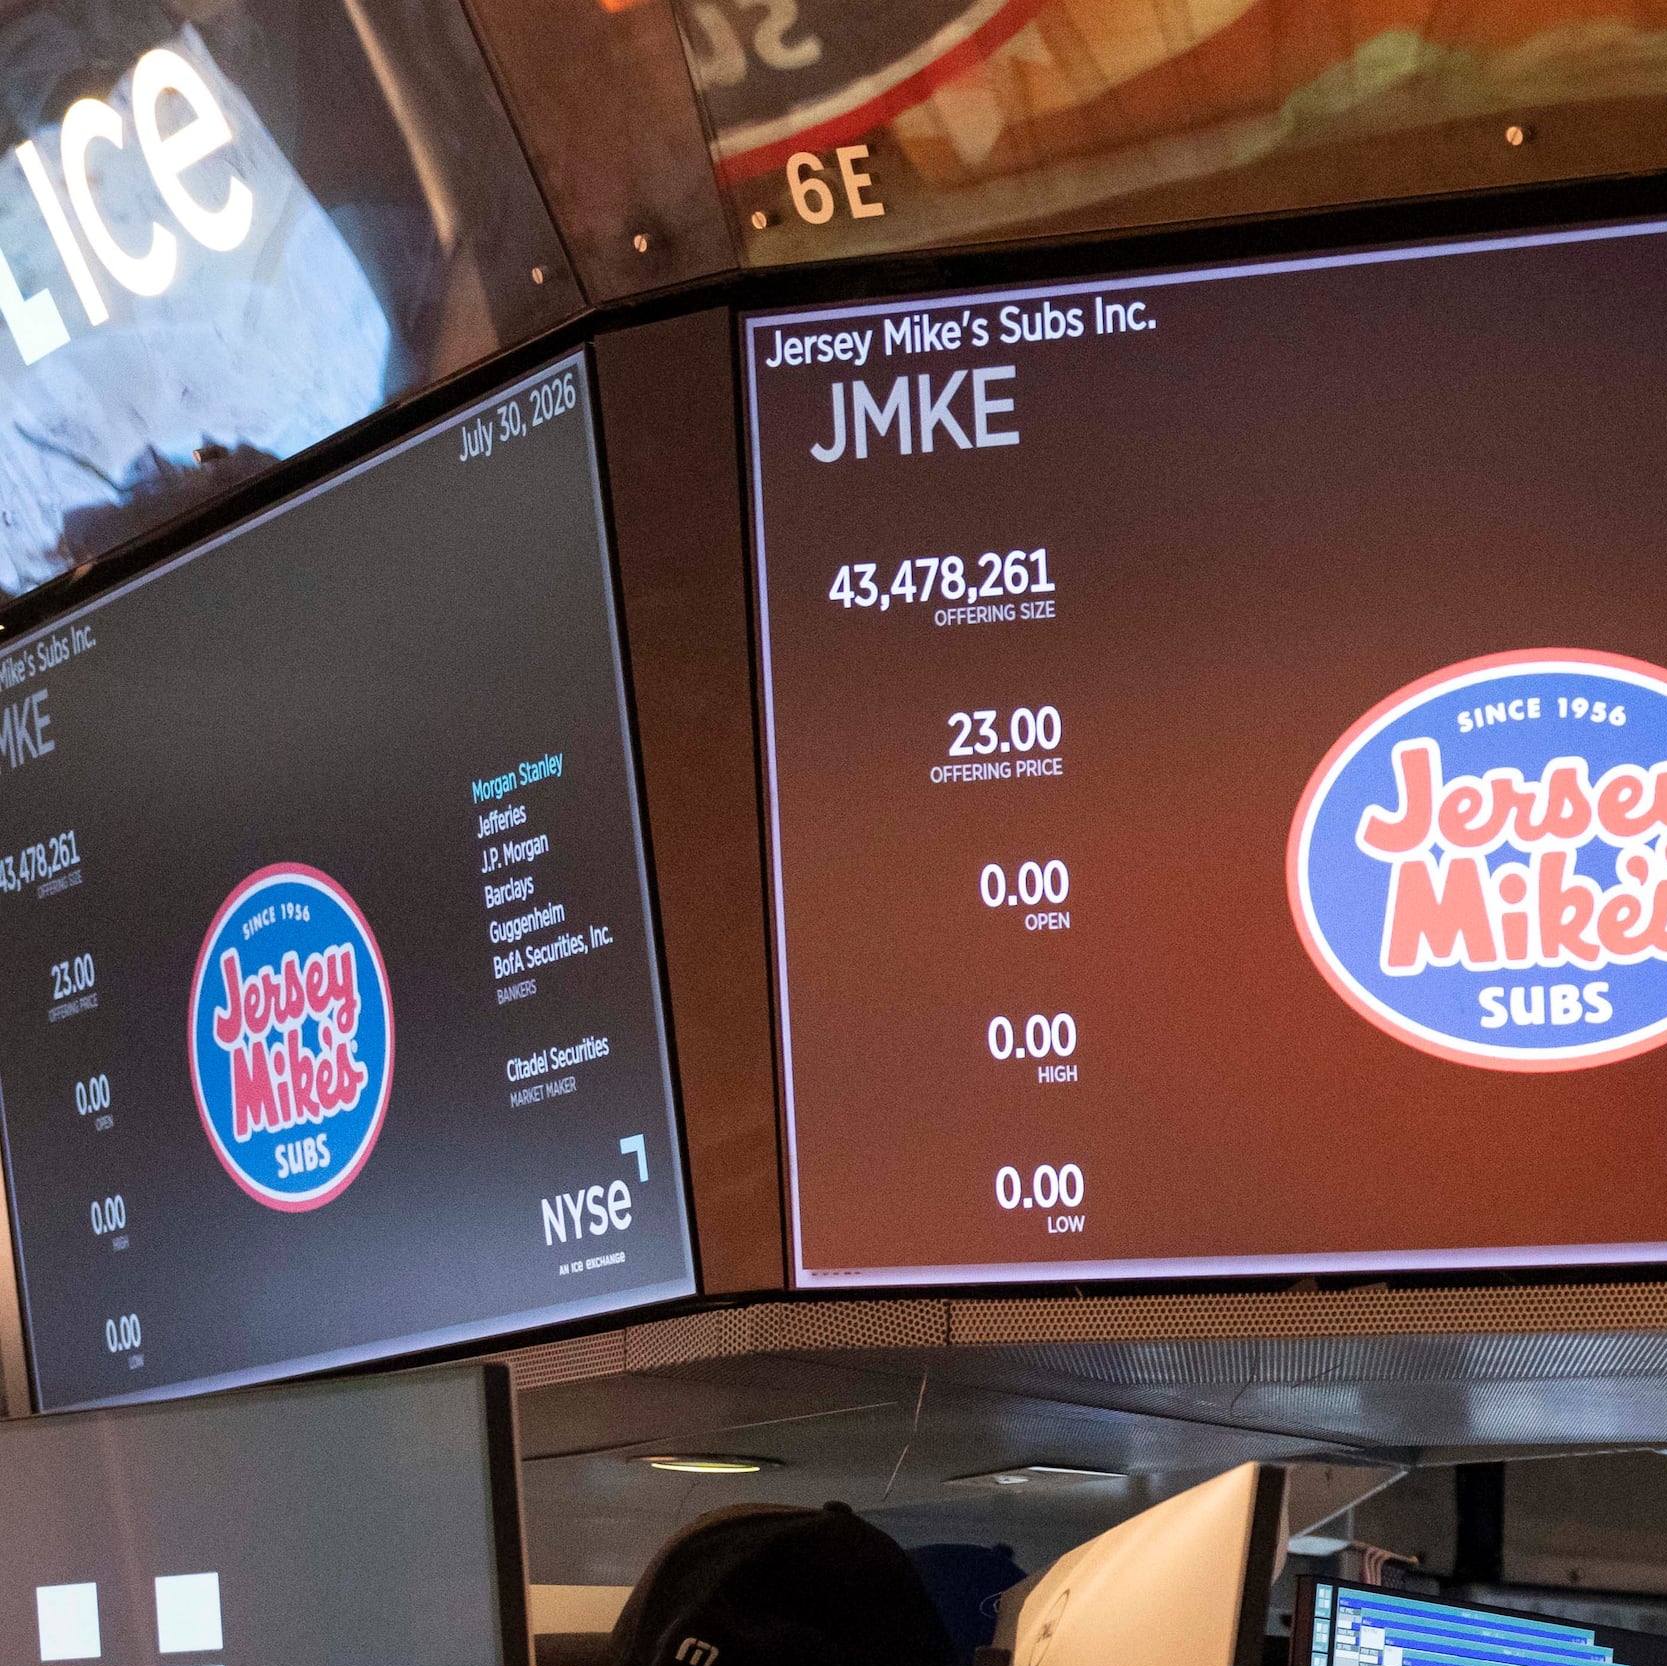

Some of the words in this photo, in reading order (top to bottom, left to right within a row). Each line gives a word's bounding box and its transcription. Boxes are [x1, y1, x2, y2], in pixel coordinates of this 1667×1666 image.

[784, 143, 884, 224] 6E
[766, 330, 872, 367] Jersey
[884, 311, 989, 355] Mike's
[1000, 302, 1084, 343] Subs
[1096, 297, 1156, 334] Inc.
[459, 417, 493, 461] July
[498, 402, 526, 441] 30,
[531, 374, 576, 426] 2026
[811, 365, 1019, 462] JMKE
[829, 549, 1055, 611] 43,478,261
[935, 604, 1015, 626] OFFERING
[1021, 601, 1055, 619] SIZE
[37, 636, 69, 671] Subs
[71, 626, 96, 654] Inc.
[948, 706, 1061, 756] 23.00
[1458, 697, 1541, 733] SINCE
[1557, 697, 1627, 727] 1956
[472, 772, 517, 803] Morgan
[518, 753, 563, 787] Stanley
[931, 762, 1011, 783] OFFERING
[1016, 758, 1063, 777] PRICE
[478, 805, 526, 838] Jefferies
[482, 847, 501, 873] J.P.
[503, 835, 548, 865] Morgan
[485, 877, 534, 908] Barclays
[981, 860, 1068, 907] 0.00
[243, 906, 275, 940] SINCE
[281, 902, 310, 921] 1956
[489, 902, 566, 944] Guggenheim
[1025, 912, 1070, 930] OPEN
[494, 950, 524, 979] BofA
[526, 934, 588, 968] Securities,
[590, 926, 613, 948] Inc.
[52, 954, 94, 999] 23.00
[213, 942, 364, 1048] Jersey
[497, 979, 536, 1004] BANKERS
[1479, 981, 1613, 1028] SUBS
[507, 1050, 548, 1081] Citadel
[550, 1036, 609, 1069] Securities
[988, 1014, 1076, 1059] 0.00
[76, 1074, 110, 1115] 0.00
[228, 1032, 368, 1143] Mike's
[510, 1085, 543, 1107] MARKET
[546, 1076, 576, 1097] MAKER
[1038, 1065, 1077, 1083] HIGH
[275, 1134, 330, 1178] SUBS
[996, 1164, 1083, 1209] 0.00
[91, 1195, 125, 1234] 0.00
[1048, 1216, 1085, 1233] LOW
[106, 1314, 141, 1352] 0.00
